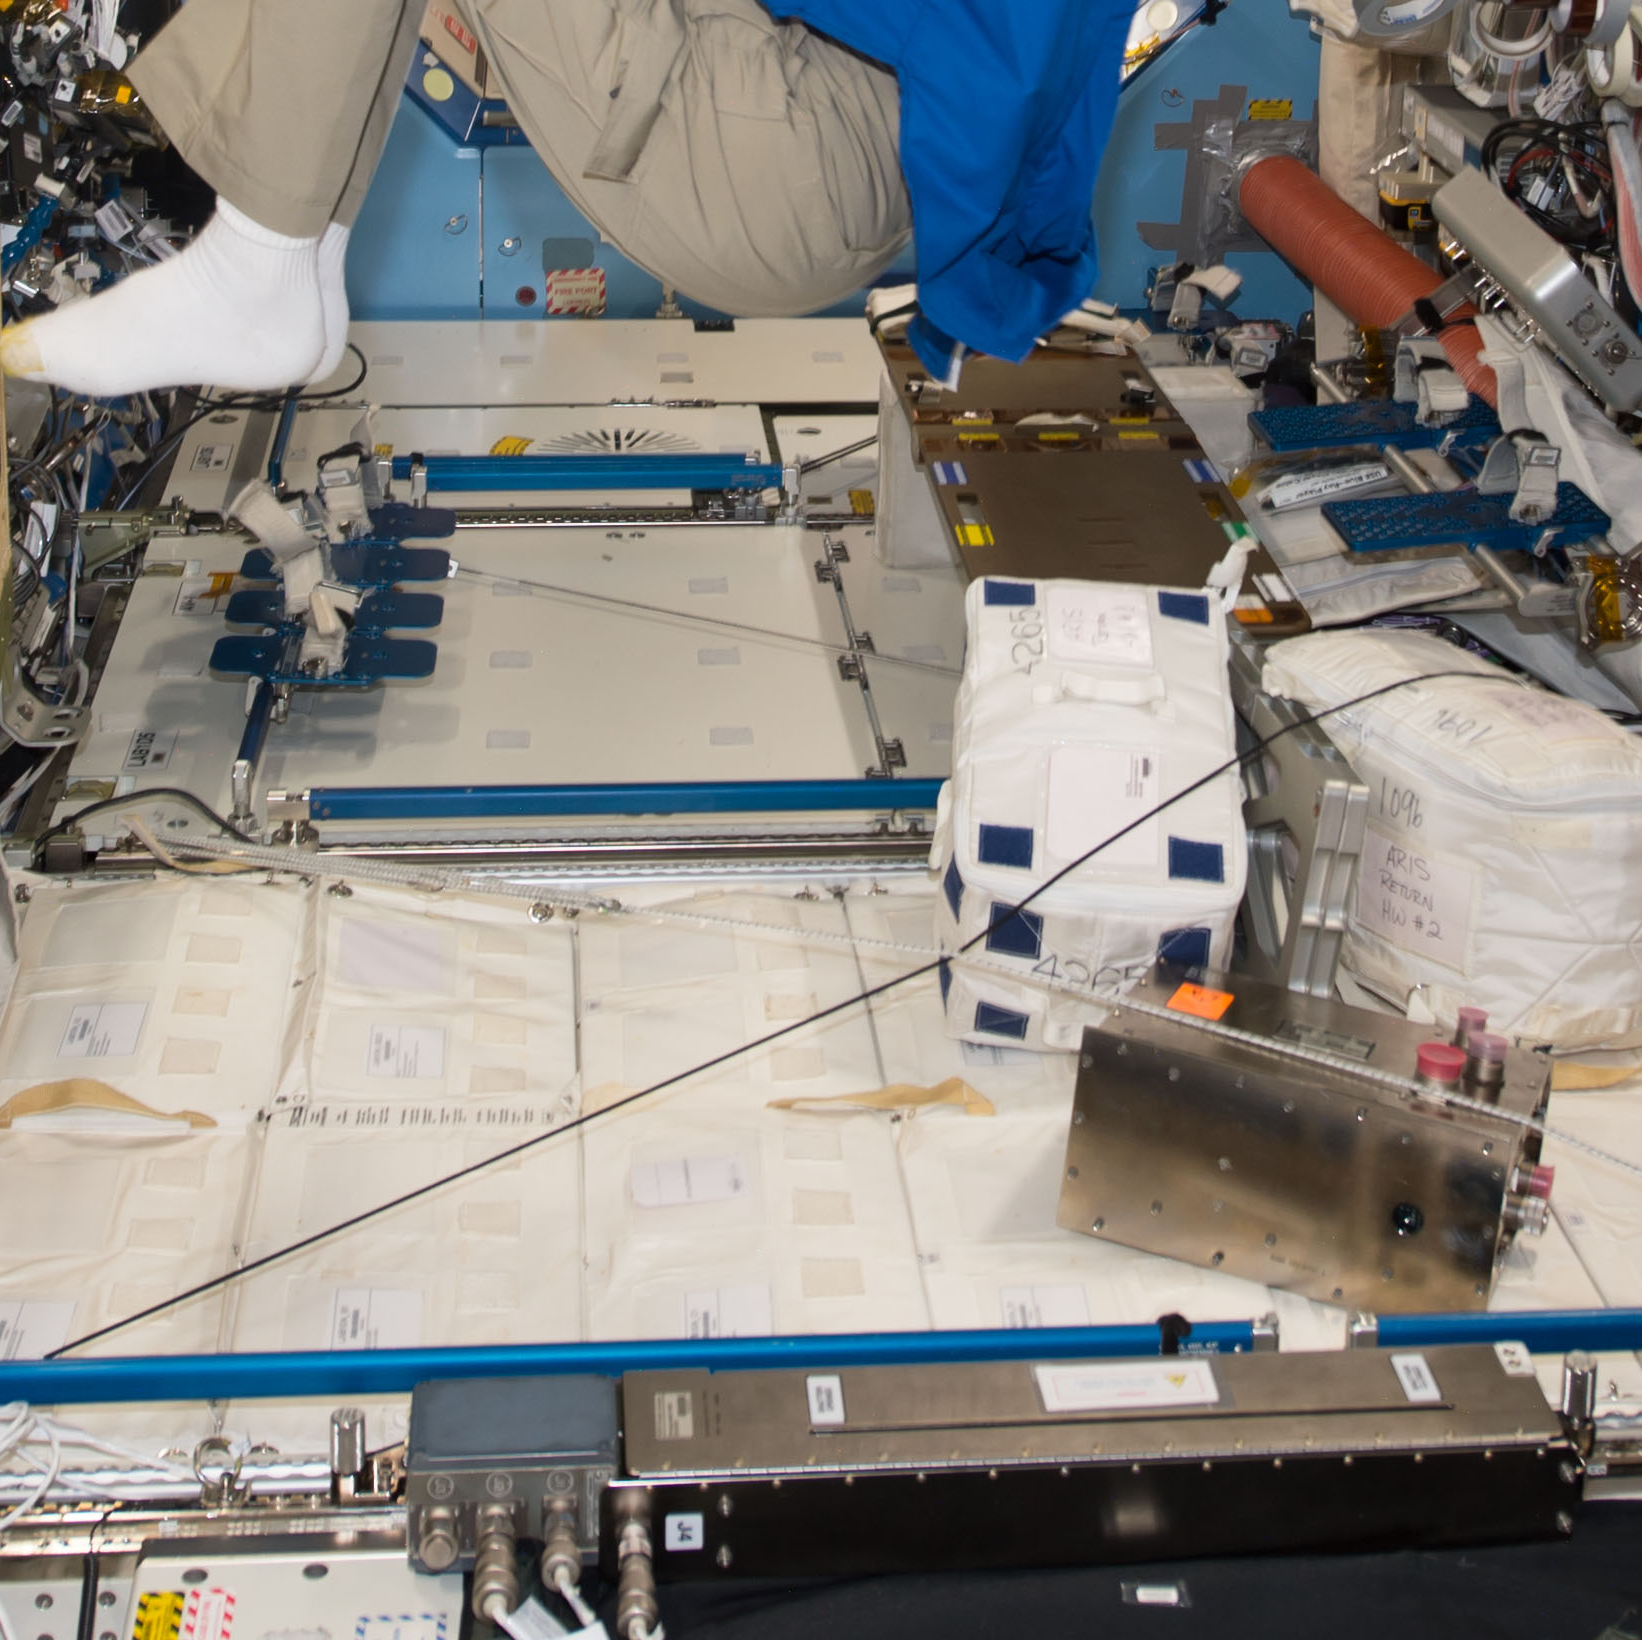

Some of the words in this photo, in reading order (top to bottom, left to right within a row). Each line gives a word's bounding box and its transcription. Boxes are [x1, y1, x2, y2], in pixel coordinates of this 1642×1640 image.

[1385, 845, 1431, 882] ARIS
[1379, 869, 1434, 912] RETURN
[1381, 899, 1407, 928] HW
[676, 1520, 694, 1543] J4
